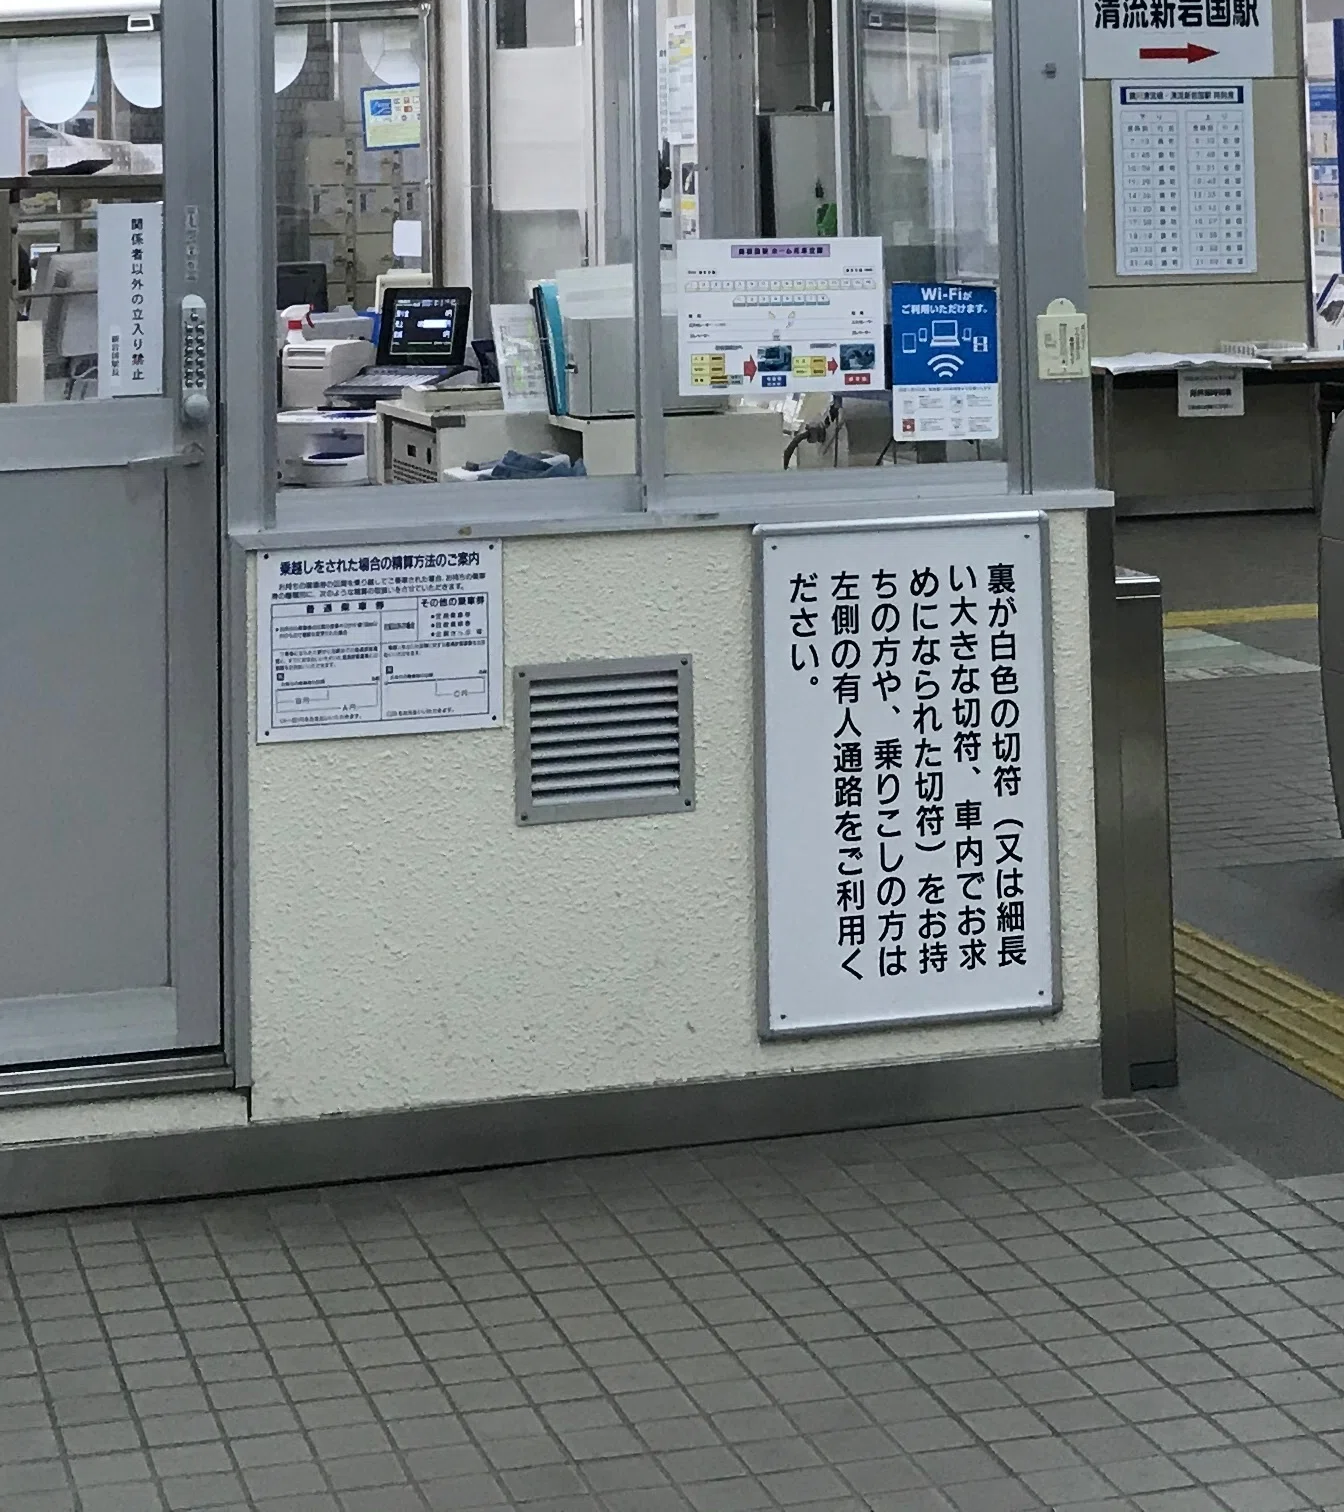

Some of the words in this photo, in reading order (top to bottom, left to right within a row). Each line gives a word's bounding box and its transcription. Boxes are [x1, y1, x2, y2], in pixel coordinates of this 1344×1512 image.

[131, 218, 145, 381] 関係者以外の立入り禁止
[901, 304, 988, 315] ご利用いただけます。
[921, 287, 972, 301] Wi-Fiが
[280, 552, 480, 577] 乗越しをされた場合の精算方法のご案内
[789, 572, 820, 686] ださい。
[830, 570, 865, 981] 左側の有人通路をご利用く
[871, 568, 907, 977] ちの方や、乗りこしの方は
